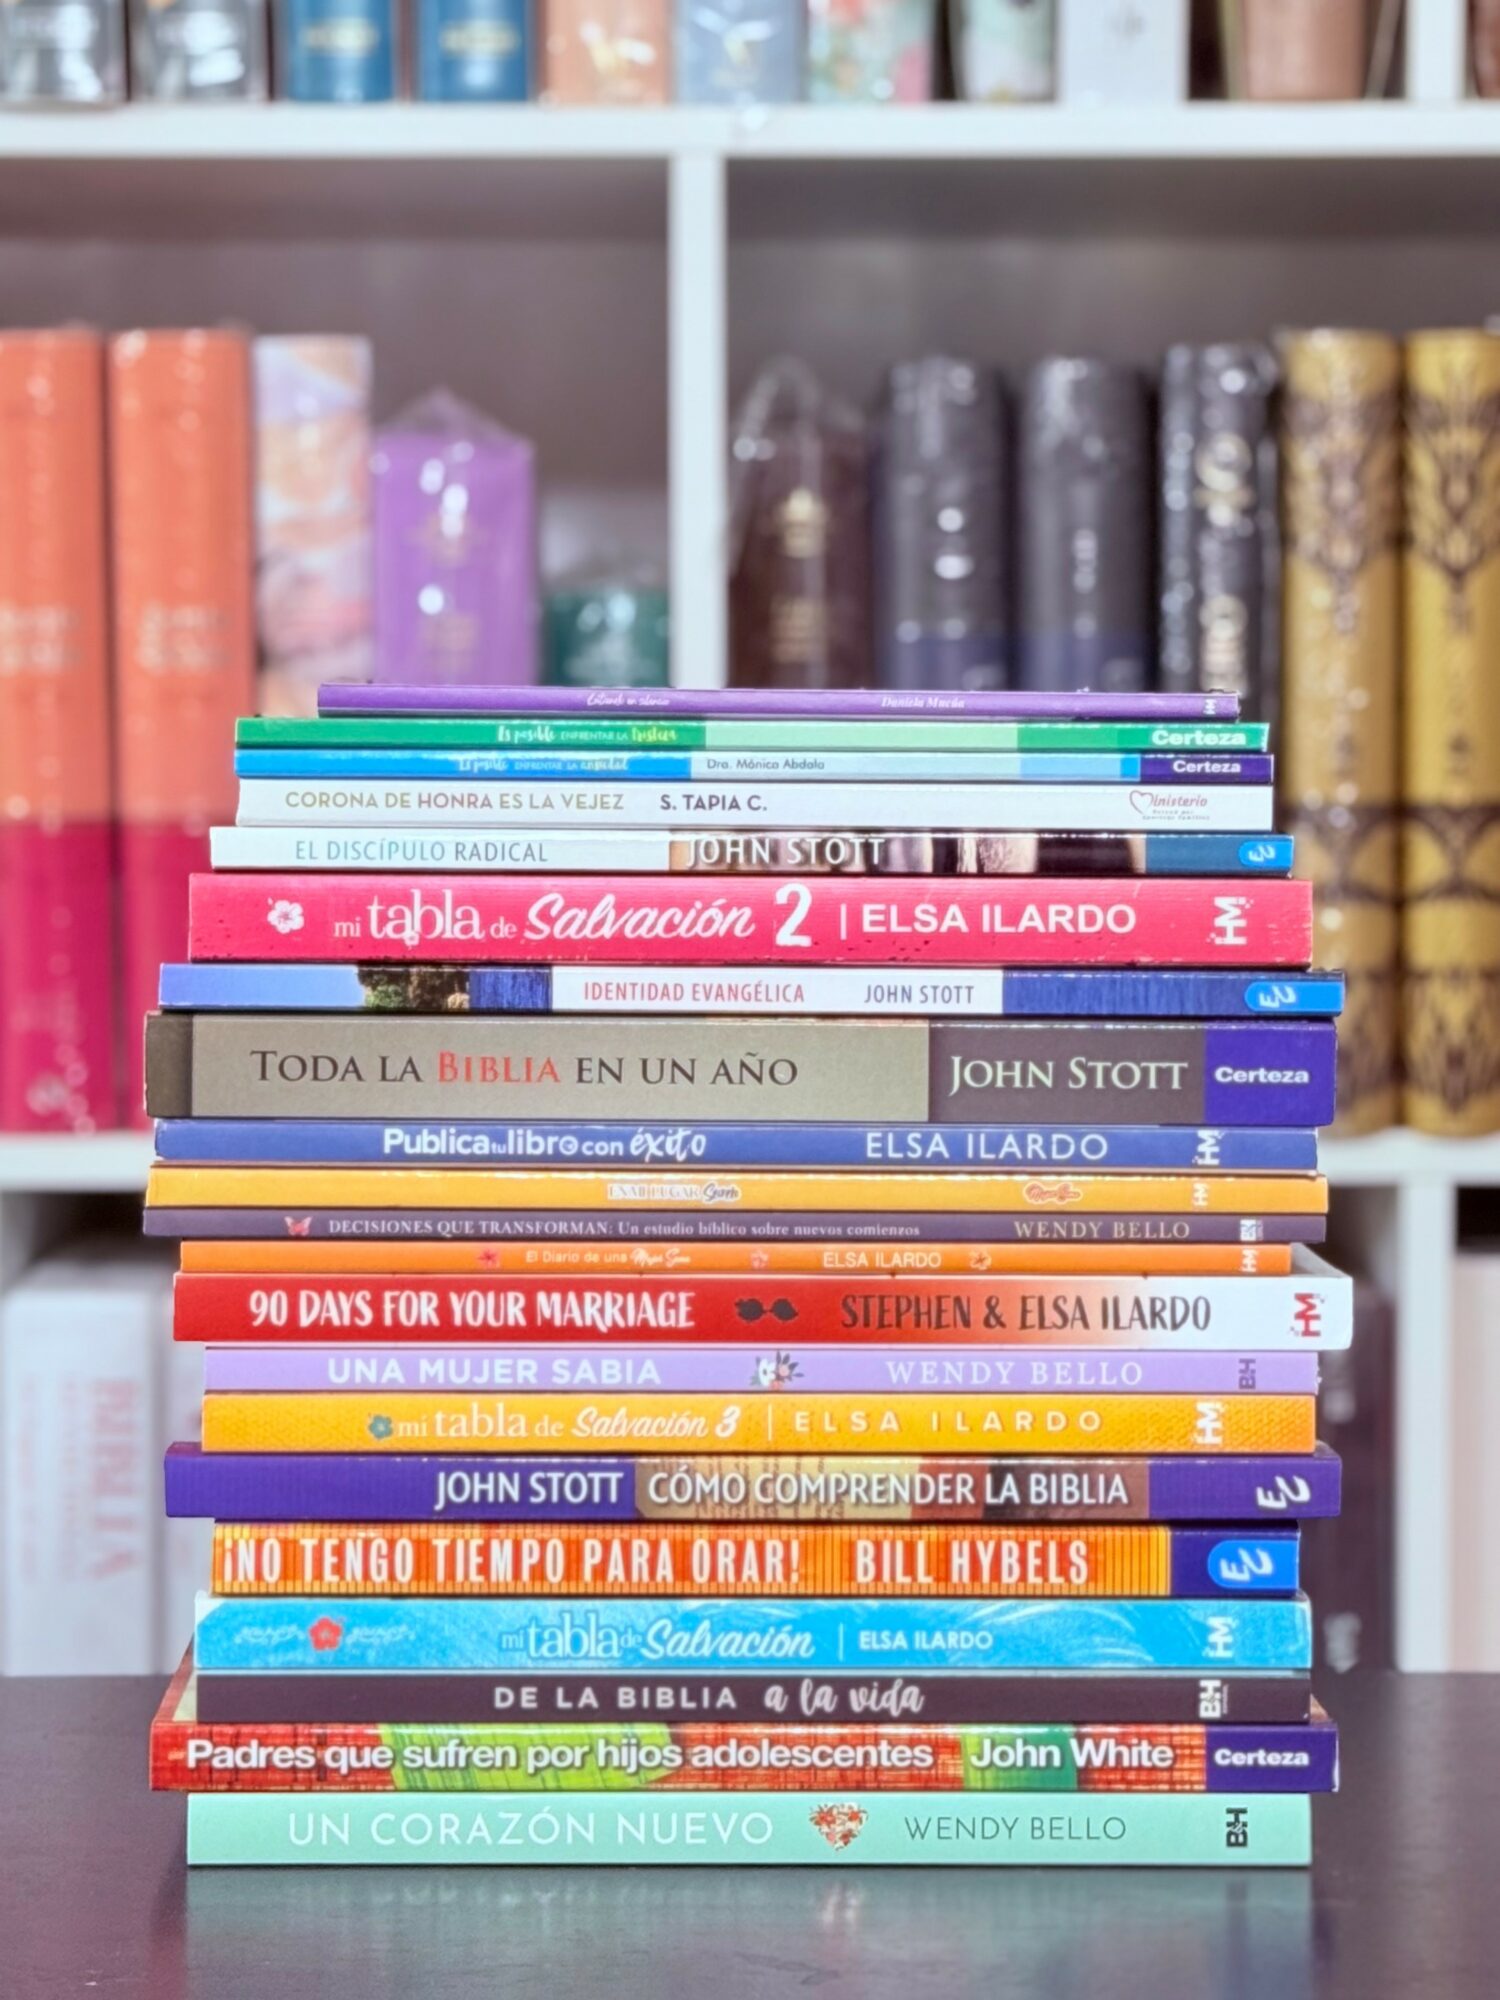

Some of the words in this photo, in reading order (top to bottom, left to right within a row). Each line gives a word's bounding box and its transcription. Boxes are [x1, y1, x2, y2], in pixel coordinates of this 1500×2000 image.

[514, 725, 555, 743] posible
[561, 731, 613, 741] ENFRENTAR
[616, 731, 629, 741] LA
[1152, 730, 1247, 746] Certeza
[707, 759, 732, 769] Dra.
[736, 758, 779, 769] Mónica
[783, 758, 825, 769] Abdala
[1173, 760, 1241, 773] Certeza
[285, 792, 378, 808] CORONA
[385, 792, 411, 808] DE
[418, 792, 493, 809] HONRA
[499, 793, 523, 809] ES
[529, 793, 555, 809] LA
[561, 793, 624, 810] VEJEZ
[660, 794, 677, 811] S.
[682, 794, 741, 811] TAPIA
[747, 795, 767, 811] C.
[296, 840, 318, 860] EL
[327, 838, 446, 861] DISCÍPULO
[455, 842, 548, 862] RADICAL
[686, 837, 770, 867] JOHN
[787, 837, 886, 865] STOTT
[334, 916, 362, 939] mi
[367, 889, 485, 943] tabla
[490, 918, 517, 940] de
[523, 891, 756, 941] Salvación
[775, 883, 812, 948] 2
[862, 904, 968, 934] ELSA
[982, 903, 1137, 934] ILARDO
[1213, 896, 1250, 946] HM
[584, 982, 685, 1002] IDENTIDAD
[692, 980, 805, 1003] EVANGÉLICA
[864, 985, 913, 1004] JOHN
[919, 985, 975, 1004] STOTT
[250, 1050, 364, 1084] TODA
[378, 1054, 423, 1084] LA
[438, 1051, 561, 1084] BIBLIA
[576, 1056, 624, 1084] EN
[641, 1056, 697, 1085] UN
[711, 1050, 798, 1086] AÑO
[949, 1055, 1054, 1096] JOHN
[1069, 1055, 1189, 1091] STOTT
[1214, 1066, 1310, 1086] Certeza
[383, 1127, 490, 1155] Publica
[508, 1128, 579, 1155] libro
[581, 1138, 623, 1156] con
[629, 1126, 707, 1162] éxito
[866, 1133, 950, 1160] ELSA
[967, 1133, 1108, 1161] ILARDO
[329, 1219, 433, 1235] DECISIONES
[437, 1220, 475, 1237] QUE
[479, 1220, 612, 1236] TRANSFORMAN:
[619, 1222, 639, 1235] Un
[643, 1222, 694, 1236] estudio
[699, 1222, 747, 1236] bíblico
[751, 1222, 790, 1236] sobre
[794, 1224, 843, 1237] nuevos
[847, 1223, 920, 1237] comienzos
[1013, 1221, 1103, 1239] WENDY
[1112, 1221, 1190, 1239] BELLO
[526, 1251, 538, 1263] El
[542, 1251, 579, 1263] Diario
[584, 1251, 600, 1263] de
[604, 1253, 627, 1263] una
[823, 1251, 868, 1267] ELSA
[875, 1251, 942, 1268] ILARDO
[250, 1290, 288, 1327] 90
[300, 1290, 373, 1327] DAYS
[383, 1291, 439, 1327] FOR
[450, 1290, 526, 1327] YOUR
[536, 1291, 695, 1332] MARRIAGE
[841, 1294, 971, 1330] STEPHEN
[983, 1297, 1005, 1328] &
[1019, 1295, 1090, 1331] ELSA
[1101, 1295, 1211, 1331] ILARDO
[1294, 1293, 1321, 1337] HM
[328, 1359, 404, 1385] UNA
[420, 1359, 538, 1386] MUJER
[551, 1359, 661, 1386] SABIA
[886, 1361, 1015, 1386] WENDY
[1031, 1361, 1144, 1386] BELLO
[400, 1416, 428, 1437] mi
[435, 1402, 528, 1437] tabla
[535, 1415, 564, 1437] de
[571, 1405, 708, 1438] Salvación
[714, 1406, 741, 1438] 3
[796, 1411, 900, 1431] ELSA
[932, 1411, 1102, 1432] ILARDO
[435, 1471, 519, 1510] JOHN
[530, 1471, 624, 1503] STOTT
[648, 1464, 746, 1504] CÓMO
[755, 1472, 976, 1505] COMPRENDER
[985, 1475, 1020, 1504] LA
[1030, 1474, 1128, 1505] BIBLIA
[224, 1538, 281, 1584] ¡NO
[301, 1538, 413, 1583] TENGO
[432, 1538, 564, 1583] TIEMPO
[583, 1538, 674, 1583] PARA
[691, 1538, 800, 1584] ORAR!
[856, 1539, 933, 1583] BILL
[951, 1539, 1089, 1584] HYBELS
[502, 1630, 524, 1649] mi
[528, 1613, 622, 1658] tabla
[620, 1628, 643, 1649] de
[640, 1618, 815, 1660] Salvación
[859, 1631, 908, 1650] ELSA
[914, 1631, 993, 1651] ILARDO
[1205, 1616, 1236, 1658] HM
[494, 1687, 538, 1709] DE
[556, 1687, 599, 1709] LA
[617, 1687, 737, 1709] BIBLIA
[764, 1684, 788, 1712] a
[800, 1679, 838, 1715] la
[849, 1680, 925, 1715] vida
[187, 1738, 316, 1769] Padres
[325, 1745, 395, 1775] que
[403, 1738, 518, 1769] sufren
[526, 1745, 589, 1775] por
[599, 1738, 683, 1774] hijos
[691, 1738, 934, 1768] adolescentes
[969, 1738, 1061, 1768] John
[1069, 1738, 1174, 1768] White
[1214, 1748, 1310, 1768] Certeza
[289, 1812, 350, 1846] UN
[371, 1806, 596, 1846] CORAZÓN
[616, 1812, 773, 1846] NUEVO
[905, 1816, 1017, 1841] WENDY
[1031, 1816, 1127, 1841] BELLO
[1226, 1806, 1248, 1847] B&H
